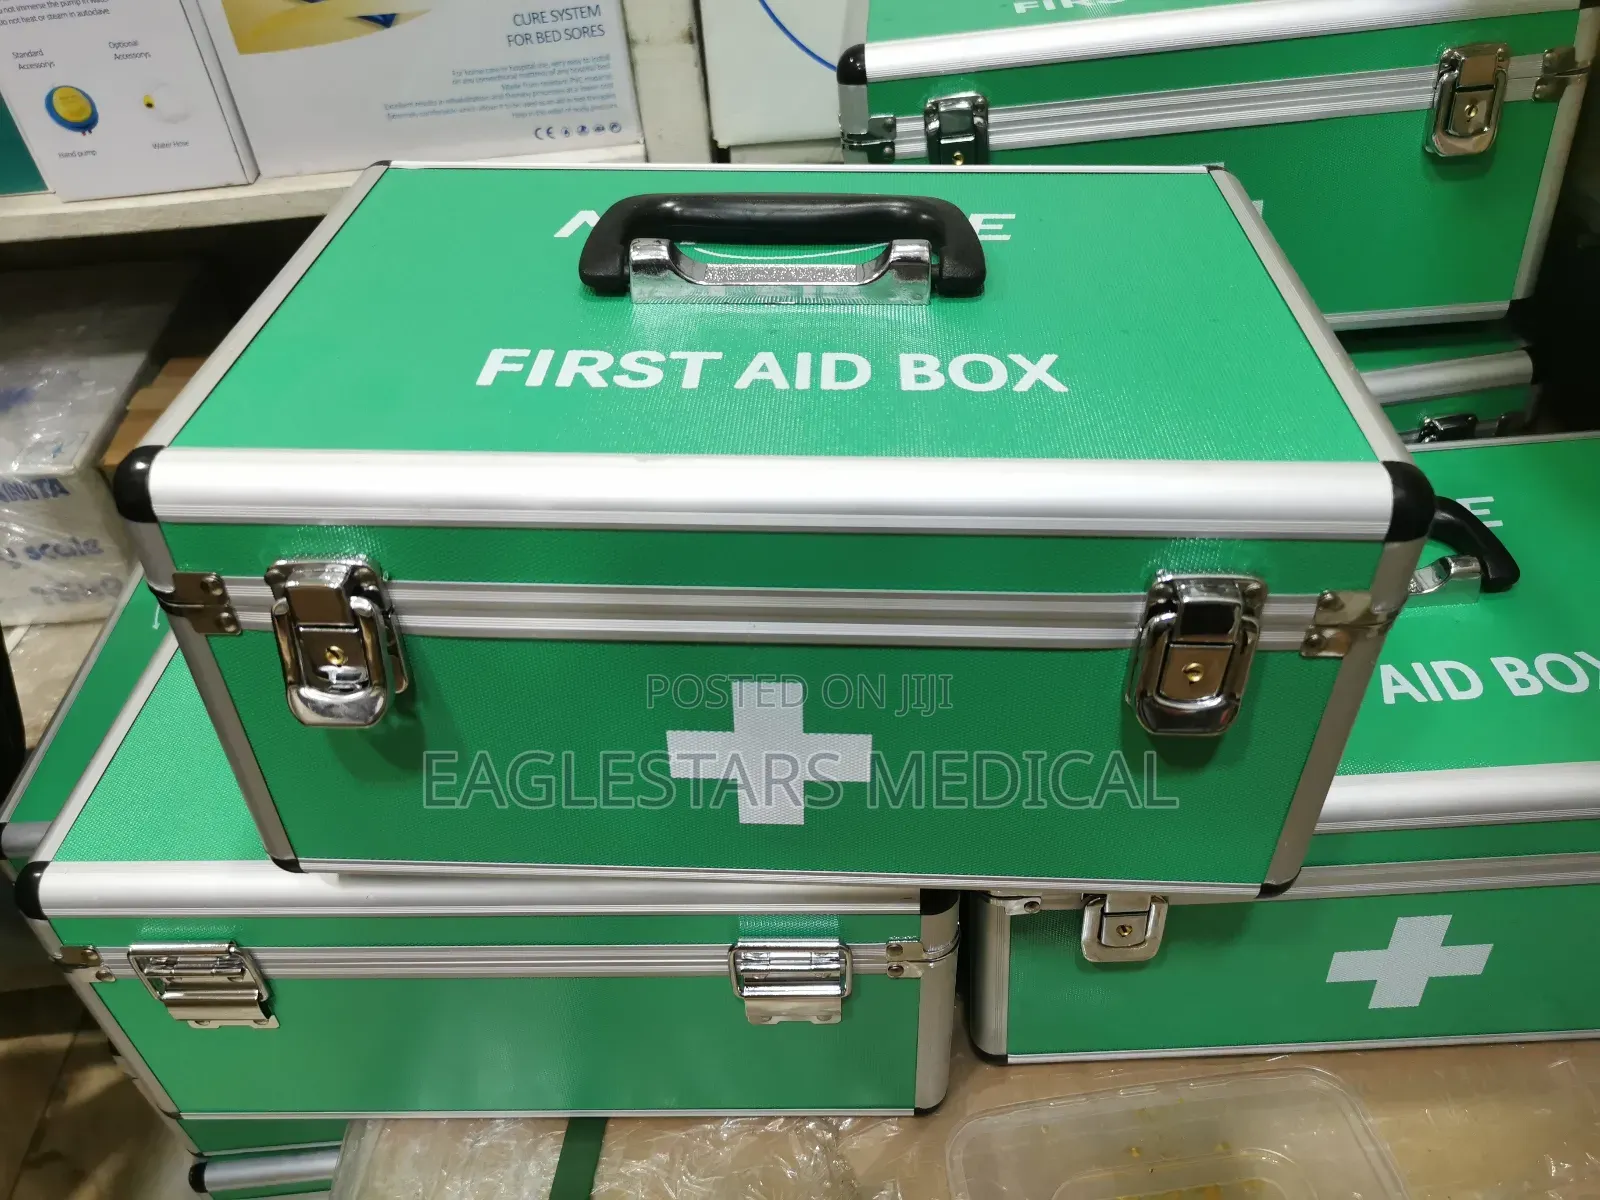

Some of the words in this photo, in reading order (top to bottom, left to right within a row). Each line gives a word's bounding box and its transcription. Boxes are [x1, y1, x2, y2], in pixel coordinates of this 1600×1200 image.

[513, 11, 549, 26] CURE
[550, 4, 602, 23] SYSTEM
[506, 33, 534, 47] FOR
[535, 29, 562, 44] BED
[563, 24, 606, 41] SORES
[475, 348, 723, 389] FIRST
[733, 351, 872, 390] AID
[899, 353, 1069, 392] BOX
[1379, 659, 1484, 704] AID
